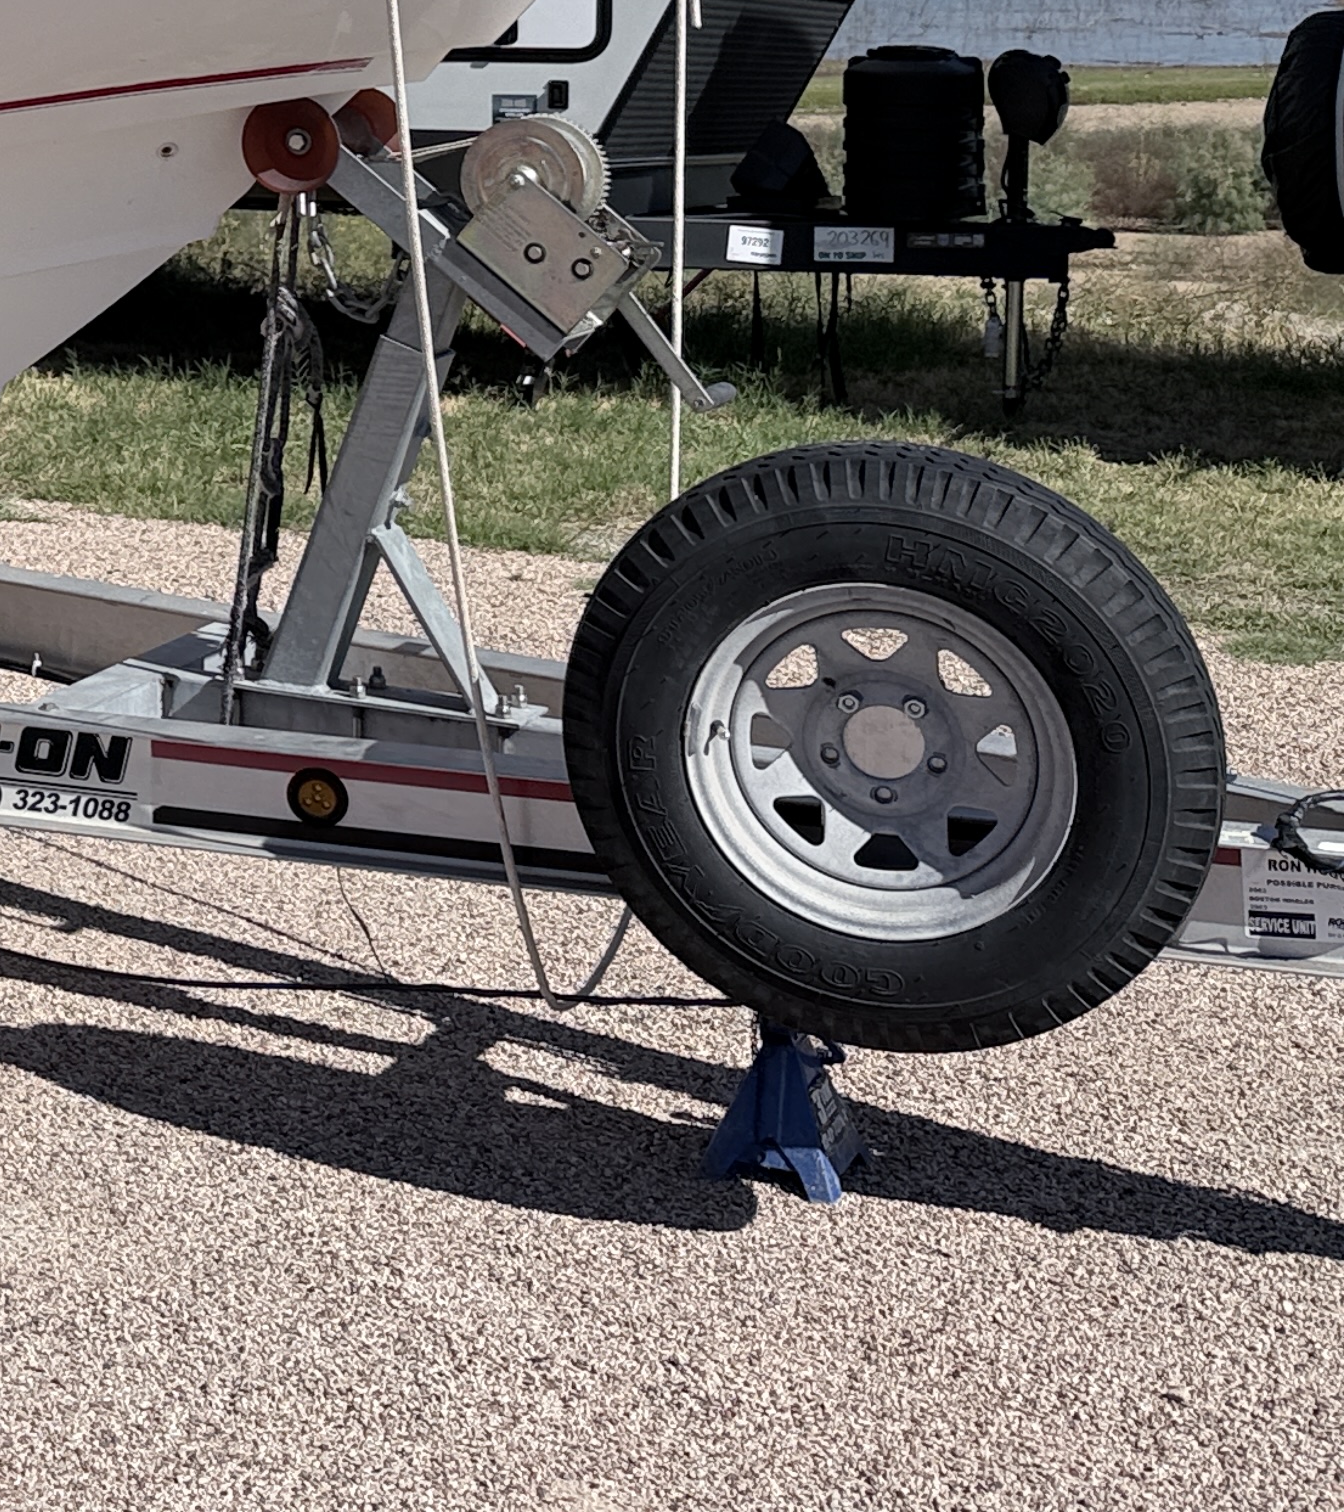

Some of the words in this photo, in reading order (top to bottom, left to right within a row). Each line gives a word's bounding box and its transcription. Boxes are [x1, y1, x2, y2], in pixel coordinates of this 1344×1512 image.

[12, 788, 132, 823] 323-1088
[1268, 858, 1301, 873] RON
[1266, 878, 1314, 889] POSSIBLE
[1249, 917, 1290, 934] SERVICE
[1292, 919, 1316, 936] UNIT
